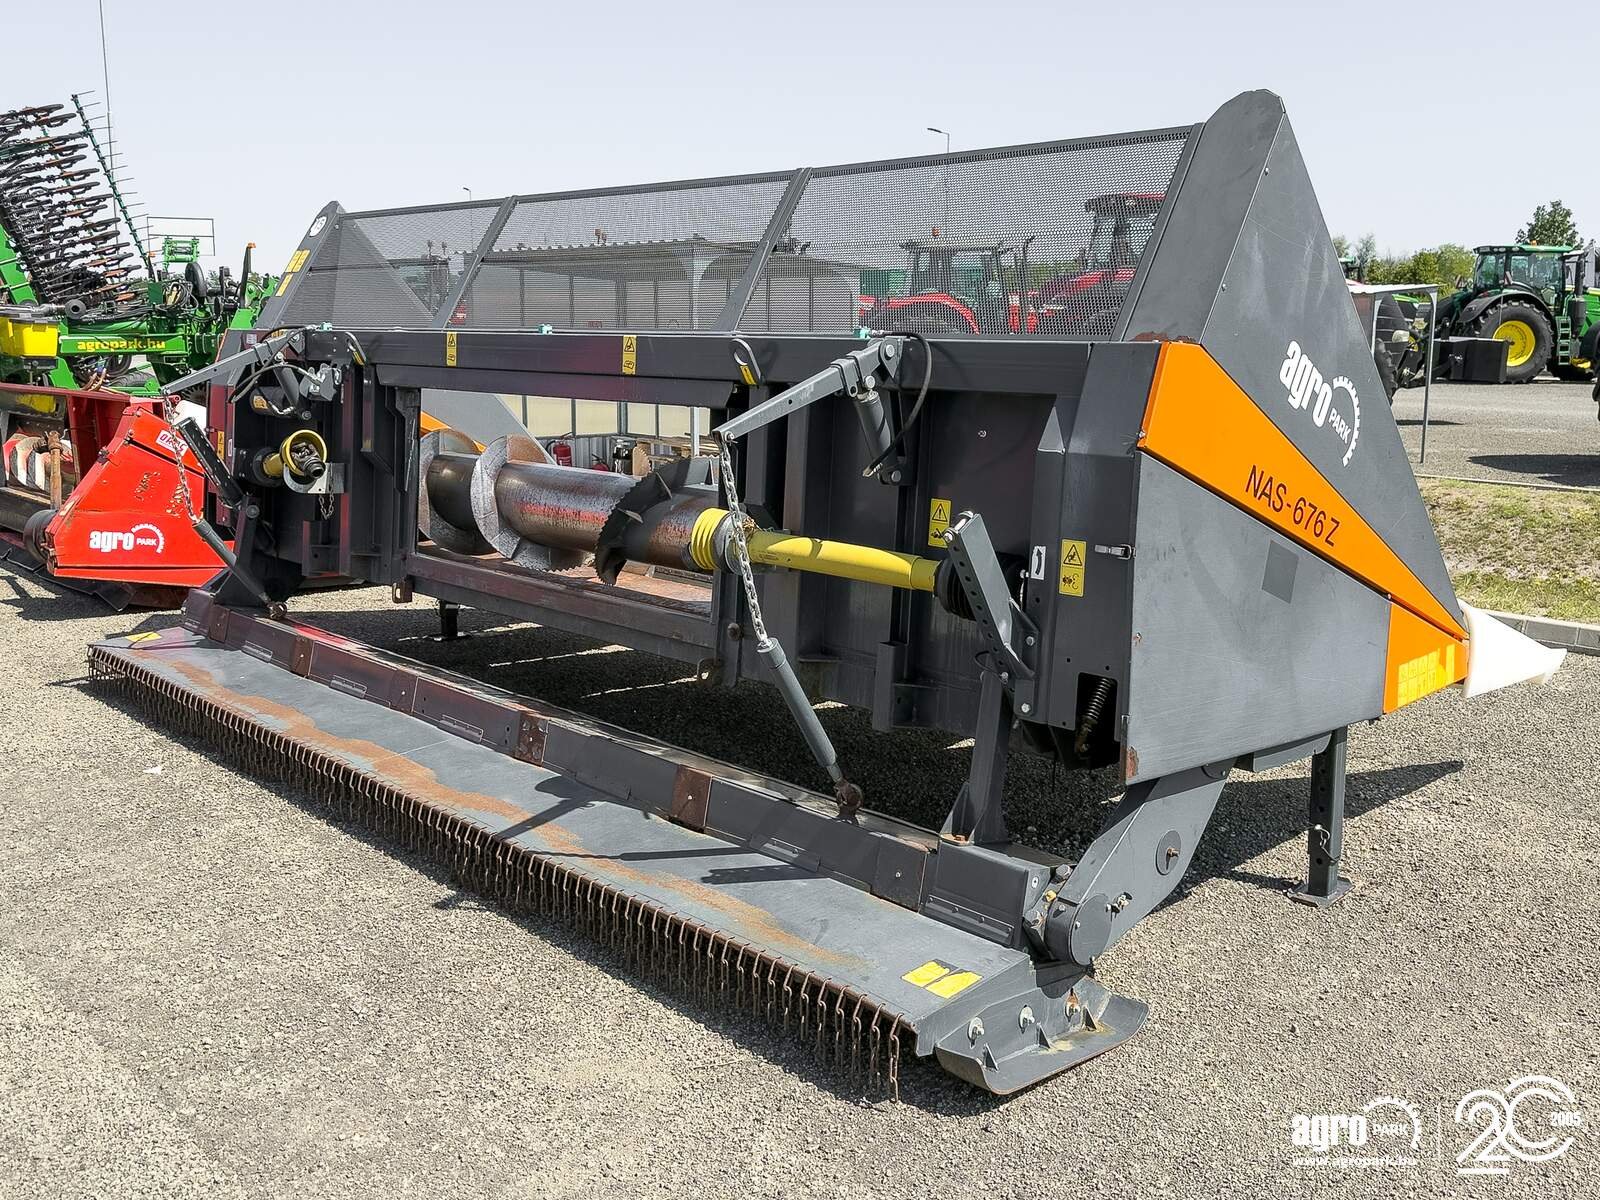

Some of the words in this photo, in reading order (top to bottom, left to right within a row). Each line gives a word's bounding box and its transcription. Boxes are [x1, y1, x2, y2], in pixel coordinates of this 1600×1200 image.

[77, 338, 165, 352] agropark.hu
[1279, 340, 1333, 428] agro
[1328, 407, 1352, 444] PARK
[1245, 464, 1327, 538] NAS-676
[89, 530, 135, 553] agro
[136, 537, 157, 546] PARK
